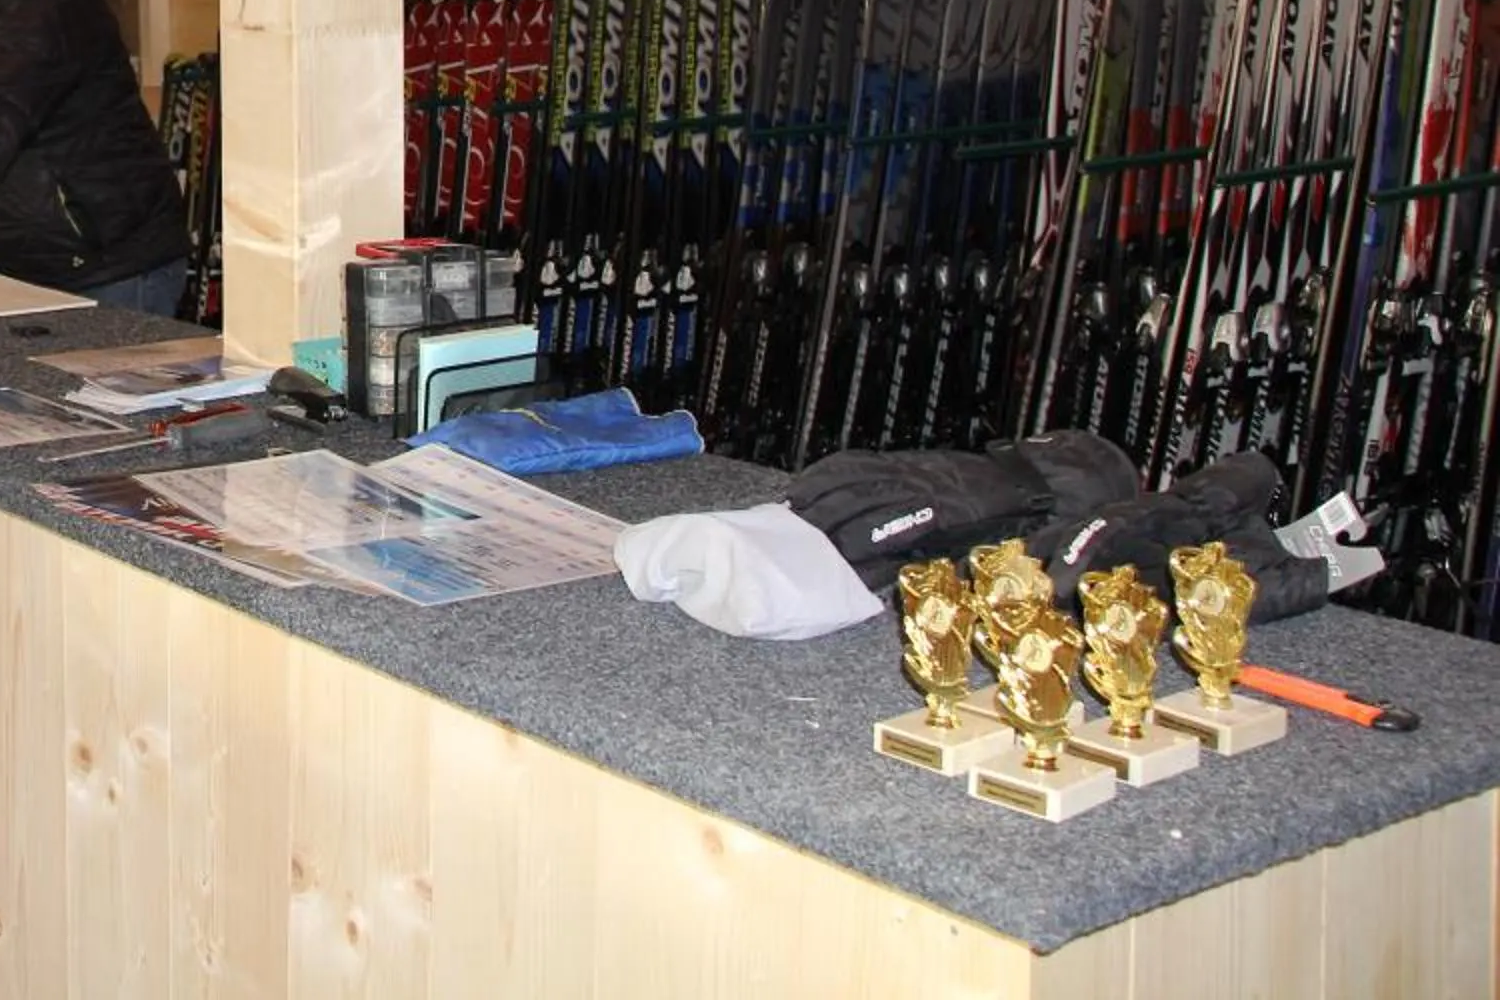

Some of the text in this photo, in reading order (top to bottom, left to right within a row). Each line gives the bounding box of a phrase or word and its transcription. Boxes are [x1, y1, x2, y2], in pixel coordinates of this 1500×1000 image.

[749, 320, 770, 408] ATOMIC
[1088, 355, 1108, 436] ATOMI
[1126, 355, 1149, 445] ATOMIC
